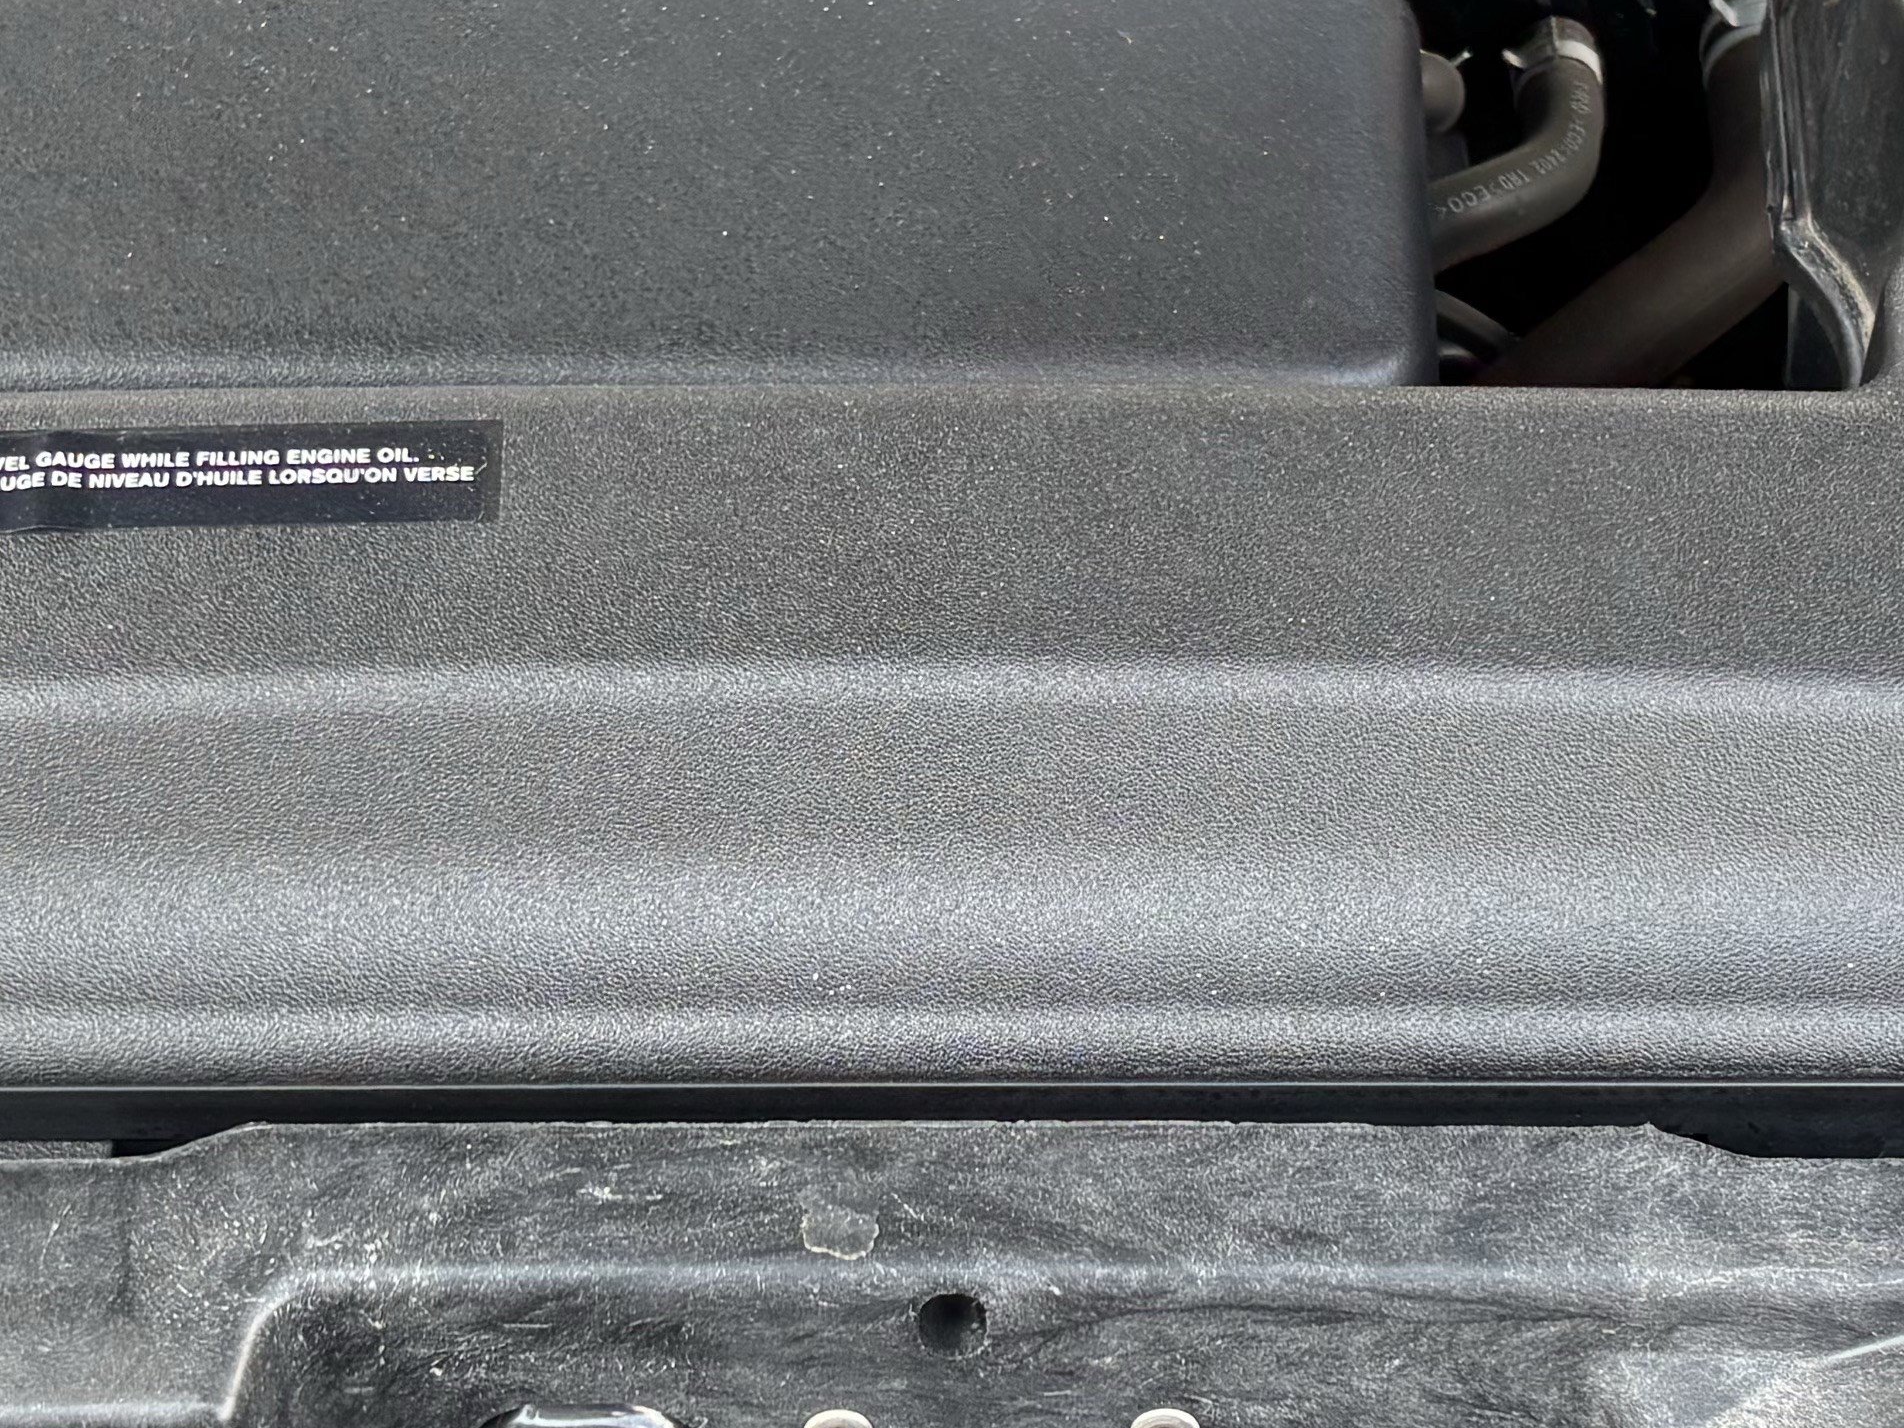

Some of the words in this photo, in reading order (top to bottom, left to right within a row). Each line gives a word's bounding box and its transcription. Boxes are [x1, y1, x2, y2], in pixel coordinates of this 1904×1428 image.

[36, 451, 115, 469] GAUGE
[121, 451, 190, 469] WHILE
[196, 450, 280, 467] FILLING
[287, 448, 371, 465] ENGINE
[377, 447, 419, 464] OIL.
[51, 471, 82, 489] DE
[89, 472, 169, 489] NIVEAU
[176, 470, 263, 487] D'HUILE
[269, 467, 397, 485] LORSQU'ON
[404, 466, 474, 483] VERSE
